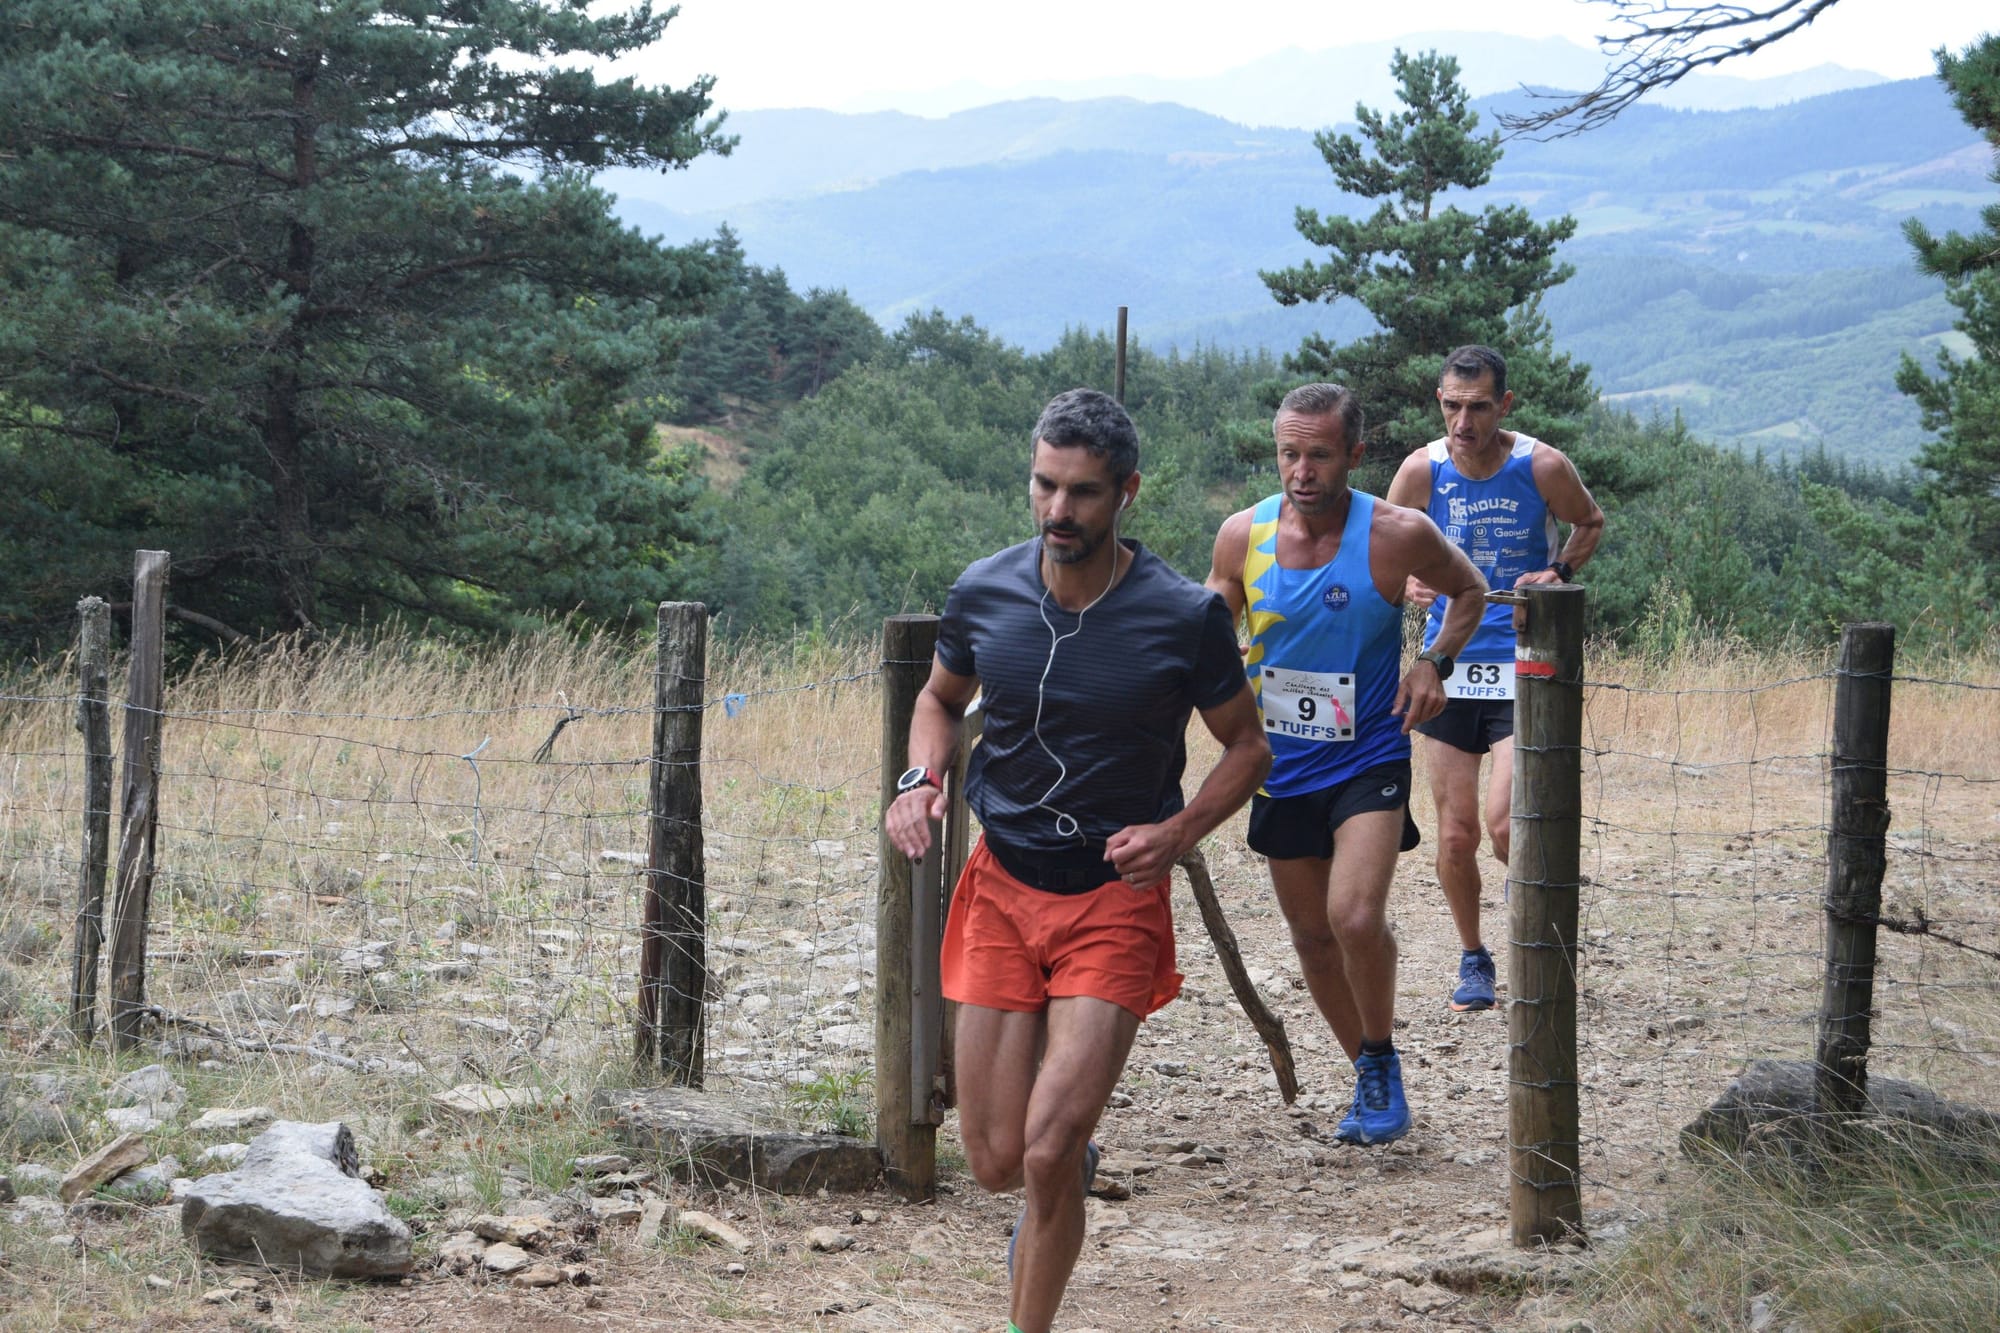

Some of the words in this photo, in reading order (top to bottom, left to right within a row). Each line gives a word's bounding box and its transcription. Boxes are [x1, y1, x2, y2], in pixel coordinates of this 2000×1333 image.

[1325, 592, 1348, 600] AZUR
[1467, 664, 1500, 685] 63
[1457, 686, 1506, 697] TUFF'S
[1298, 697, 1316, 721] 9
[1279, 720, 1336, 739] TUFF'S
